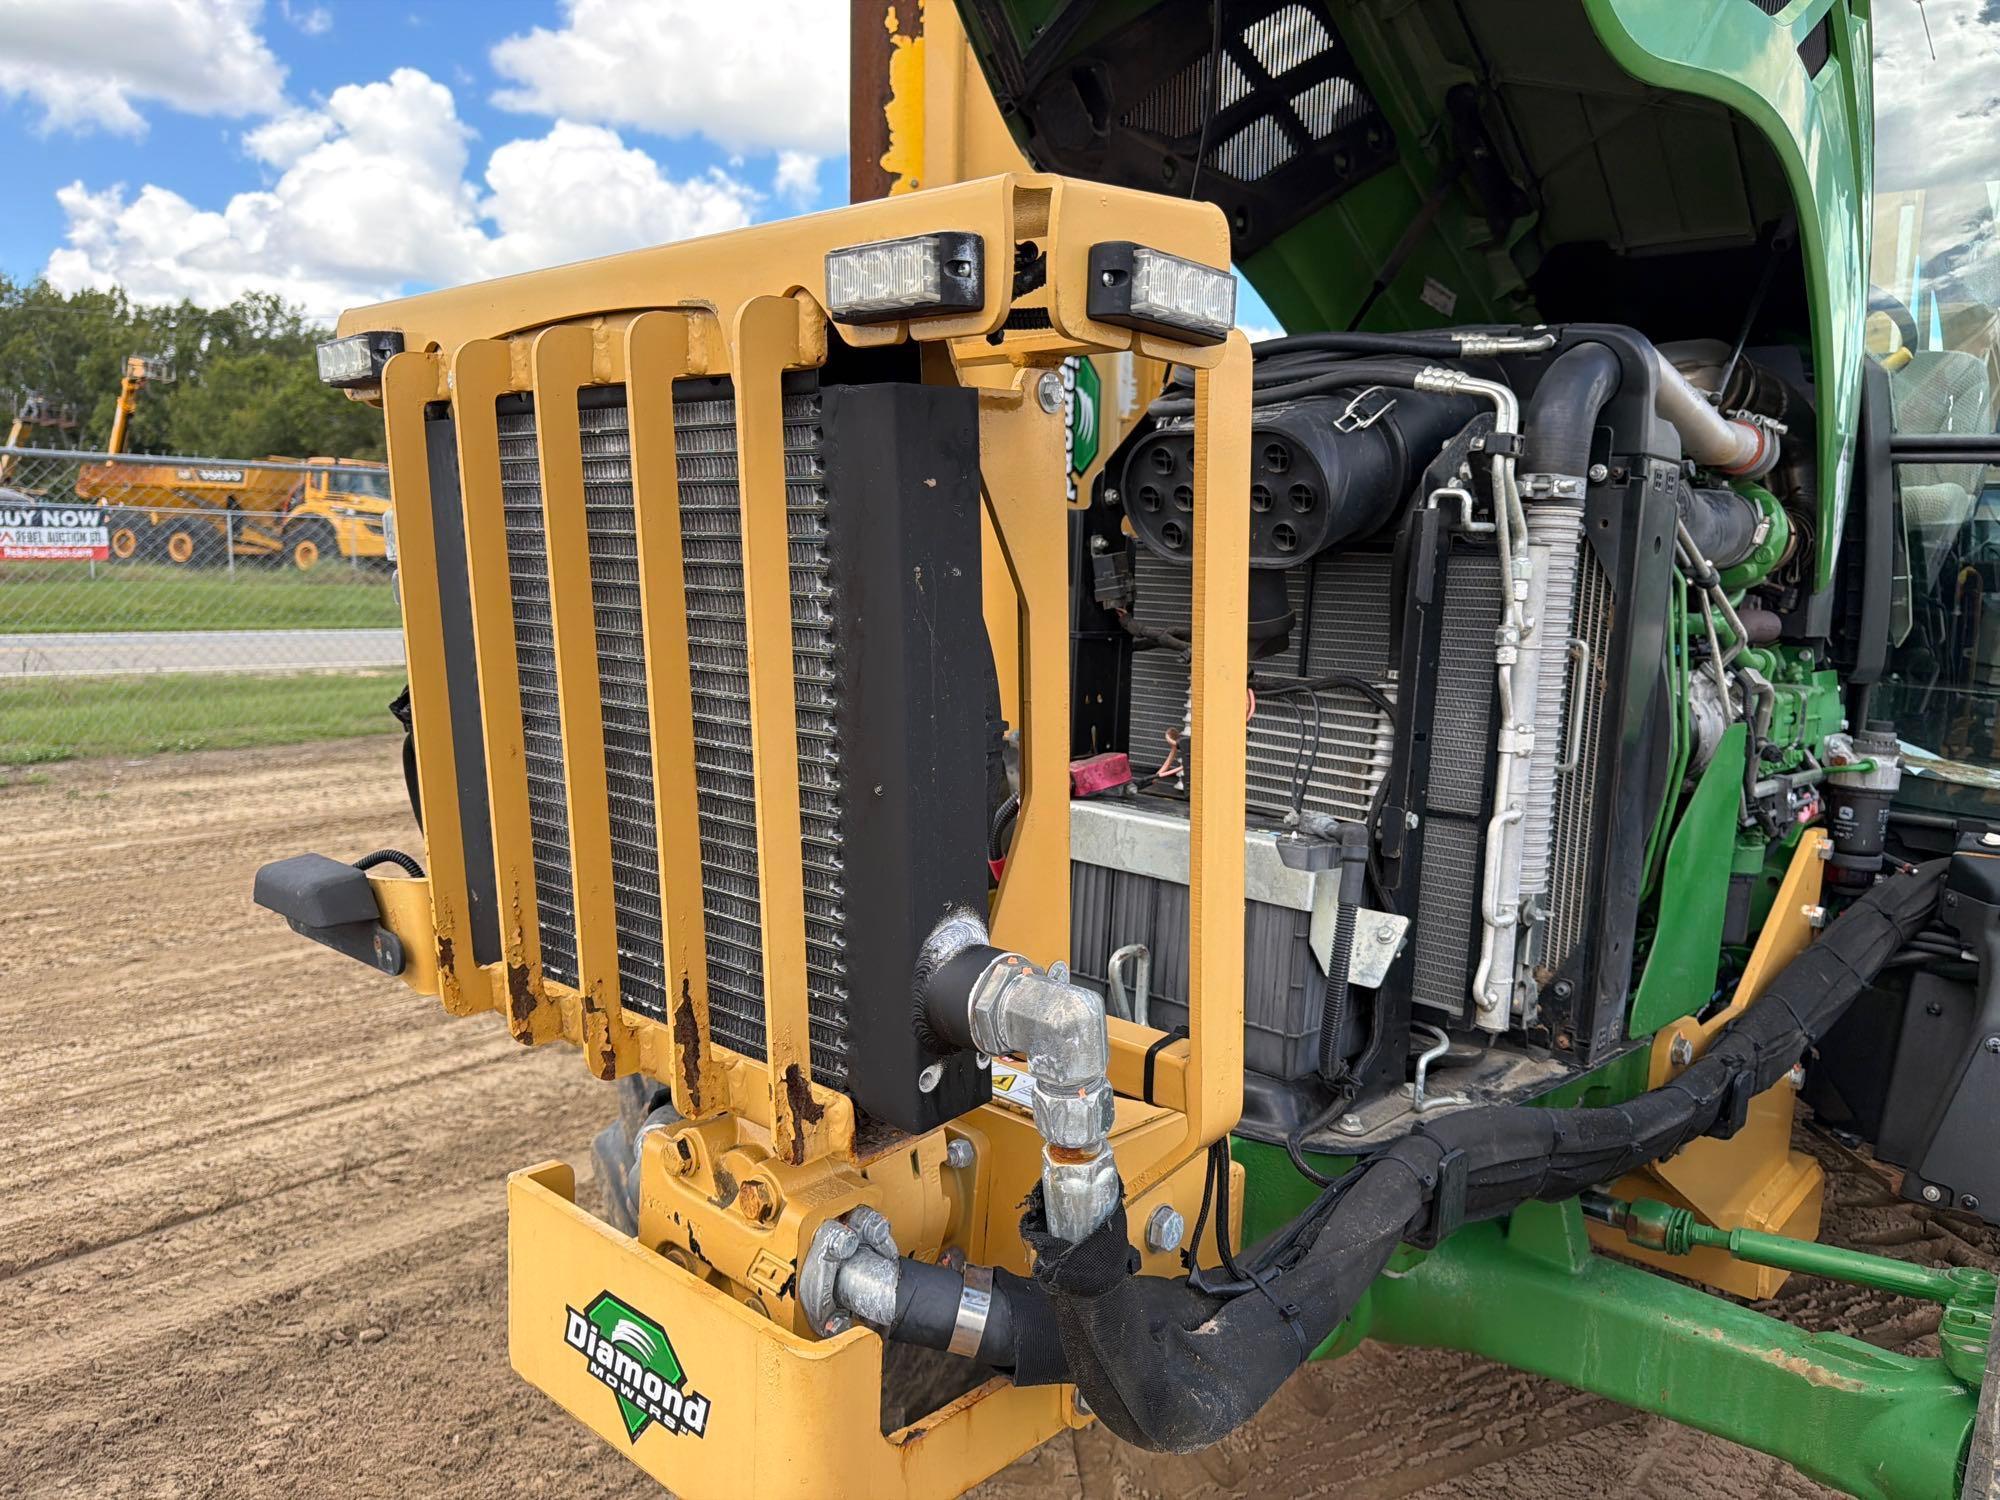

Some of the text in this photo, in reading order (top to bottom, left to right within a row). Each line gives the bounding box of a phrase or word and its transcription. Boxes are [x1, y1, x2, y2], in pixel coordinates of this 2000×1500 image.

[0, 510, 99, 526] UY NOW
[15, 531, 41, 543] REBEL
[47, 531, 86, 543] AUCTION
[567, 1310, 707, 1433] Diamond
[590, 1361, 676, 1430] MOWERS
